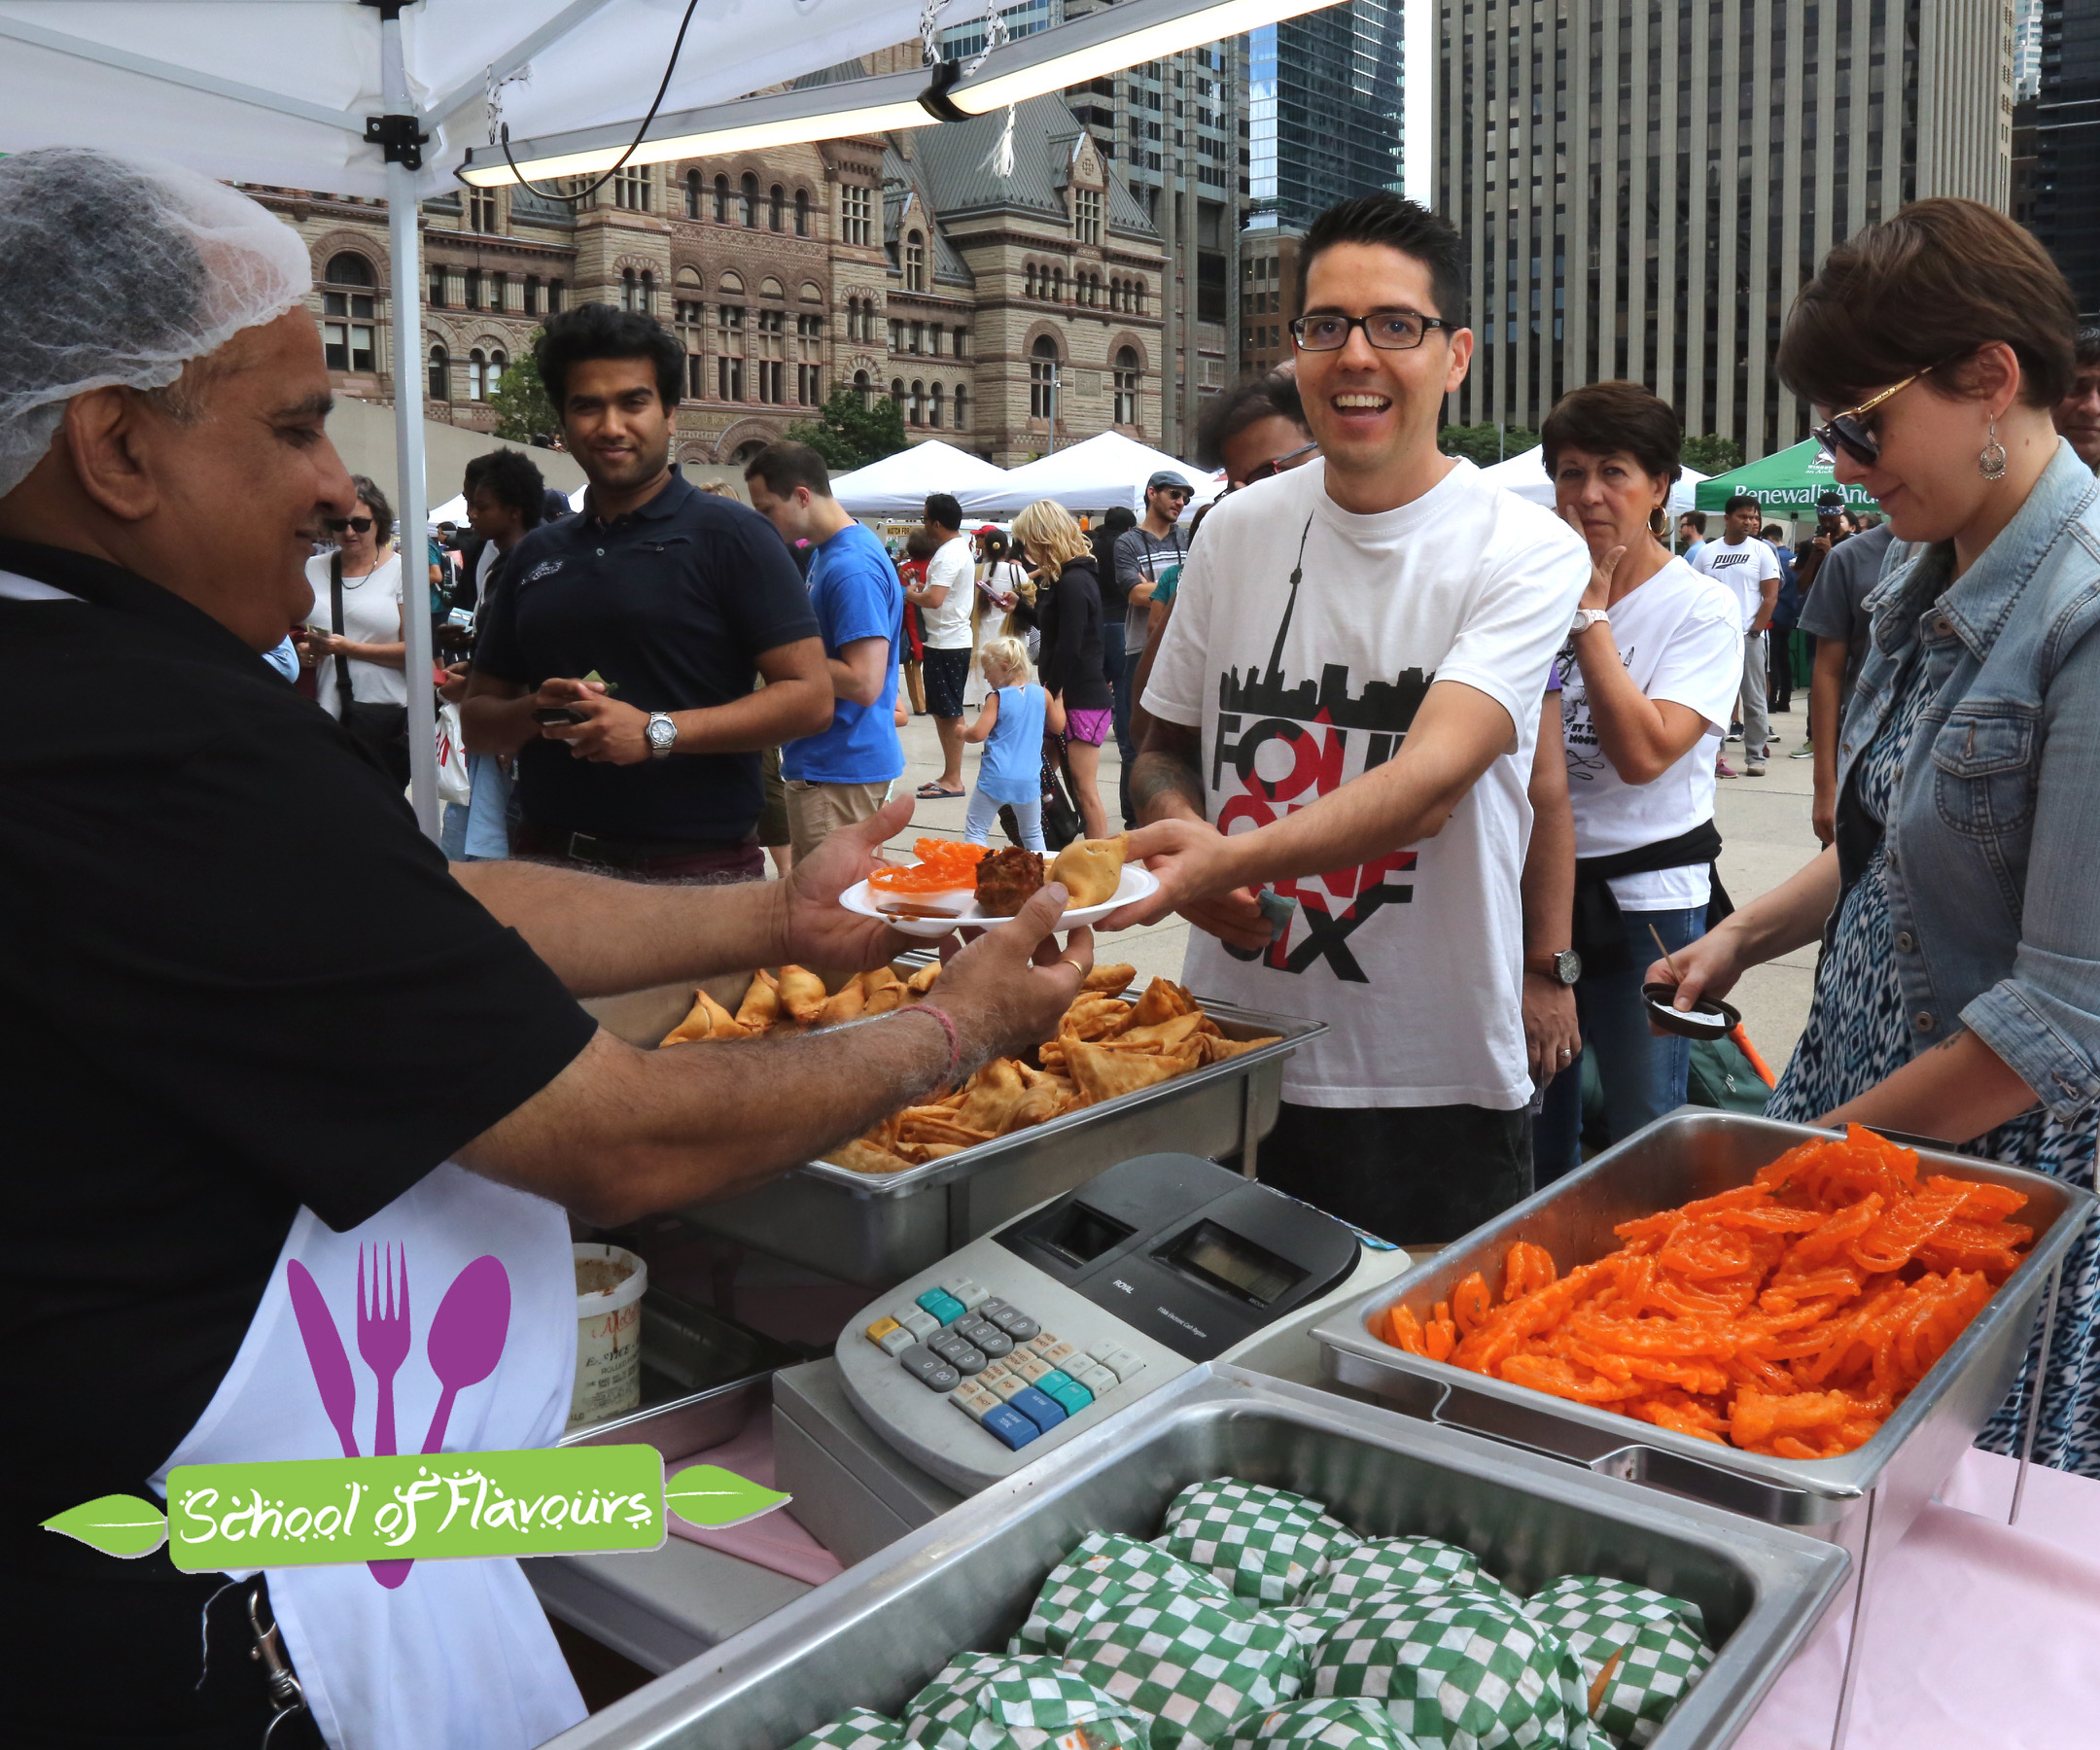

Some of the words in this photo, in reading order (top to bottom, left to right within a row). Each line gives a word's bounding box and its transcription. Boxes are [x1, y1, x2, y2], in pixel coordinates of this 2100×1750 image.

[1735, 484, 1815, 505] Renewal
[1568, 734, 1598, 746] MOON
[1212, 710, 1415, 806] FOU
[1112, 1279, 1135, 1294] ROYAL
[936, 1371, 951, 1381] 00
